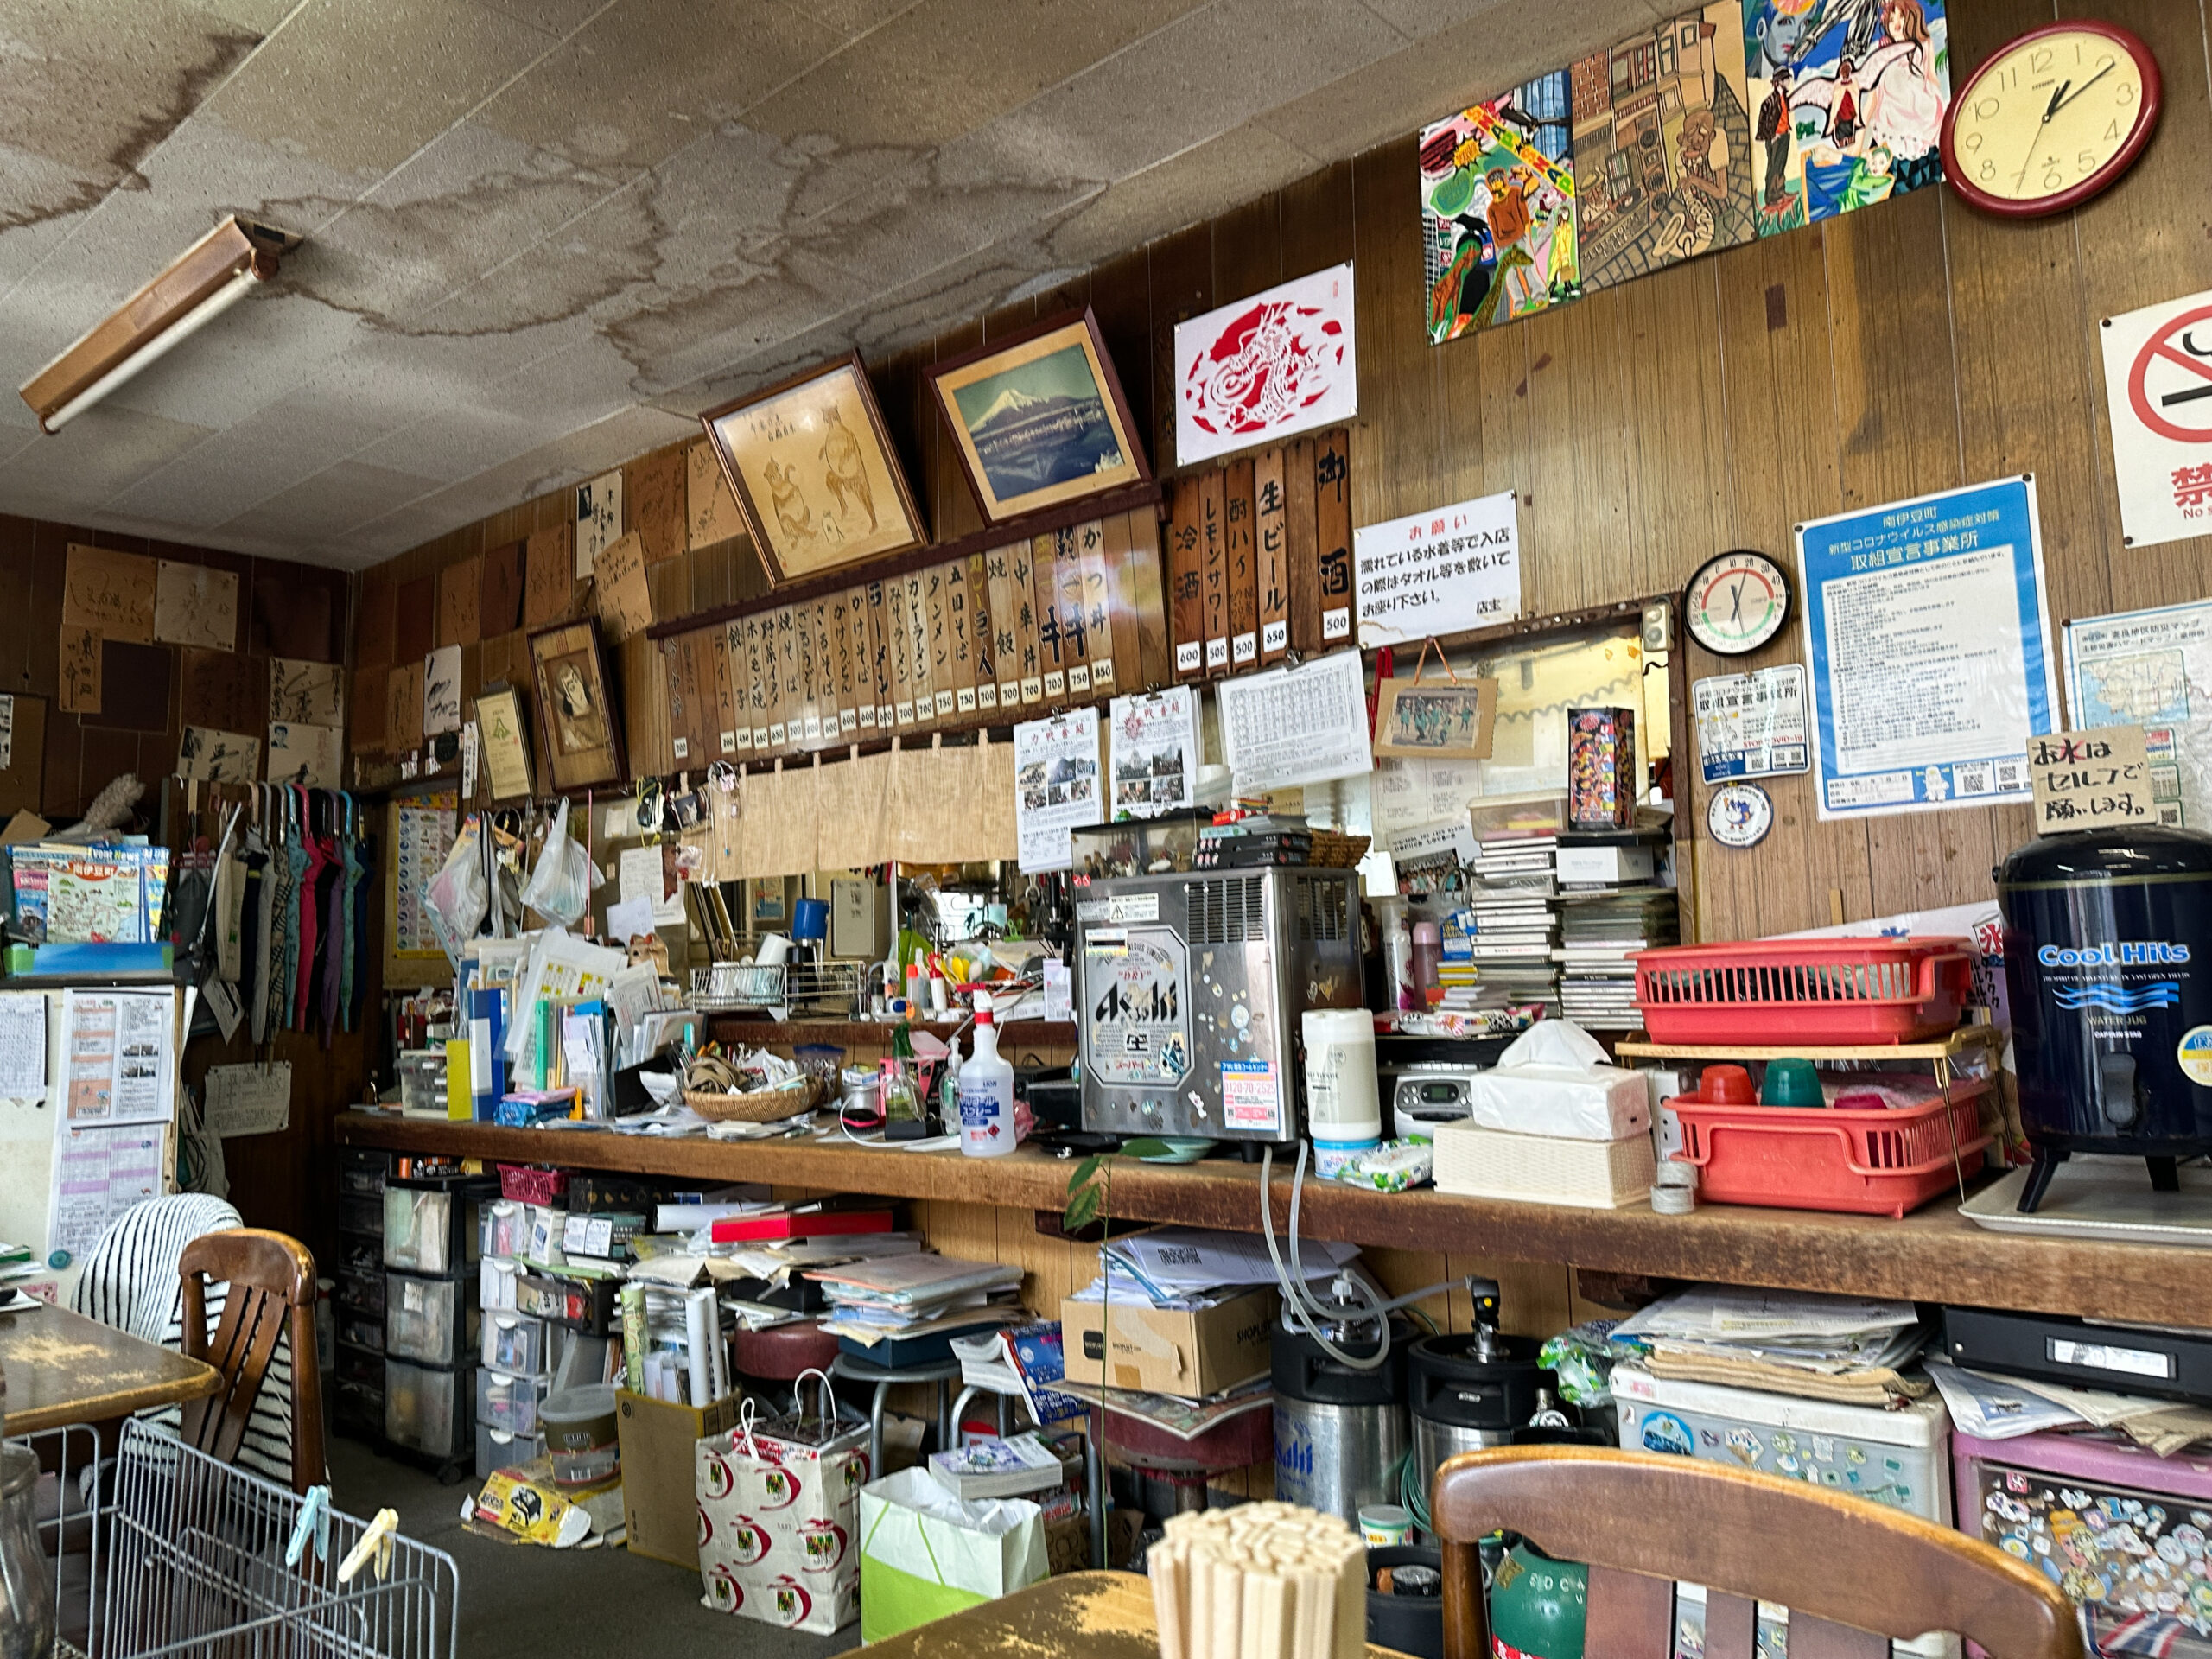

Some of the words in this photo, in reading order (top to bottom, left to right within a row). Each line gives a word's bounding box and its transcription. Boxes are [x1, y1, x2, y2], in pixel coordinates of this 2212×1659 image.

[2031, 47, 2053, 74] 12
[2075, 43, 2082, 65] 1
[1997, 67, 2017, 92] 11
[2117, 82, 2134, 106] 3
[1974, 97, 1999, 122] 10
[2103, 118, 2120, 141] 4
[1965, 132, 1983, 155] 9
[1980, 159, 1996, 181] 8
[2078, 149, 2096, 174] 5
[2044, 167, 2062, 190] 6
[1318, 446, 1350, 596] 御酒
[1883, 506, 1938, 530] 南伊豆町
[2183, 508, 2203, 520] No
[1228, 497, 1249, 579] 酎ハイ
[1408, 513, 1468, 541] お願い
[1827, 509, 2000, 556] 新型コロナウイルス感染症対策
[1259, 480, 1287, 614] 生ビール
[1359, 526, 1510, 576] 濡れている水着等で入店
[1851, 531, 1980, 572] 取組宣言事業所
[1174, 524, 1199, 601] 冷酒
[1205, 497, 1223, 632] レモンサワー
[1361, 551, 1511, 596] の際はタオル等を敷いて
[1715, 563, 1720, 574] 0
[1729, 557, 1737, 569] 10
[1745, 557, 1754, 568] 20
[1760, 563, 1770, 573] 30
[1084, 526, 1107, 635] かつ丼
[1772, 575, 1781, 585] 40
[949, 564, 969, 662] 五目そば
[988, 557, 1015, 658] 焼飯
[1362, 590, 1440, 618] お座り下さい。
[1476, 598, 1502, 616] 店主
[928, 574, 947, 665] タンメン
[1014, 558, 1037, 674] 中華丼
[1326, 616, 1347, 630] 500
[852, 594, 869, 684] かけそば
[869, 582, 888, 695] ラーメン
[889, 587, 909, 684] みそラーメン
[908, 578, 926, 679] カレーラーメン
[1266, 628, 1285, 643] 650
[778, 611, 799, 693] 焼そば
[798, 610, 816, 702] ざるうどん
[816, 600, 835, 696] ざるそば
[834, 605, 852, 694] かけうどん
[1179, 649, 1198, 663] 600
[1209, 644, 1225, 659] 500
[1236, 640, 1253, 655] 500
[715, 635, 729, 708] ライス
[728, 626, 746, 711] 餃子
[747, 620, 766, 709] ホルモン焼
[1095, 666, 1111, 679] 850
[1025, 683, 1039, 696] 700
[1046, 677, 1062, 690] 700
[1071, 672, 1087, 684] 750
[938, 696, 952, 709] 750
[959, 693, 974, 705] 750
[981, 690, 995, 702] 700
[1003, 688, 1017, 700] 700
[861, 710, 874, 722] 600
[899, 707, 912, 720] 700
[918, 702, 932, 715] 700
[1143, 700, 1180, 721] 戦奮闘
[825, 722, 837, 734] 600
[842, 714, 855, 727] 600
[1765, 734, 1803, 747] OVID-19
[2032, 738, 2112, 766] お水は
[2039, 762, 2145, 793] セルフで
[114, 848, 140, 861] News
[1979, 923, 2003, 954] 氷
[2038, 943, 2117, 967] Cool
[2122, 942, 2190, 966] Hits
[2087, 1014, 2125, 1026] WATER
[2126, 1014, 2147, 1026] JUG
[1126, 1033, 1149, 1052] 生
[1224, 1082, 1276, 1095] 0120-70-2525
[963, 1106, 992, 1117] スプレー
